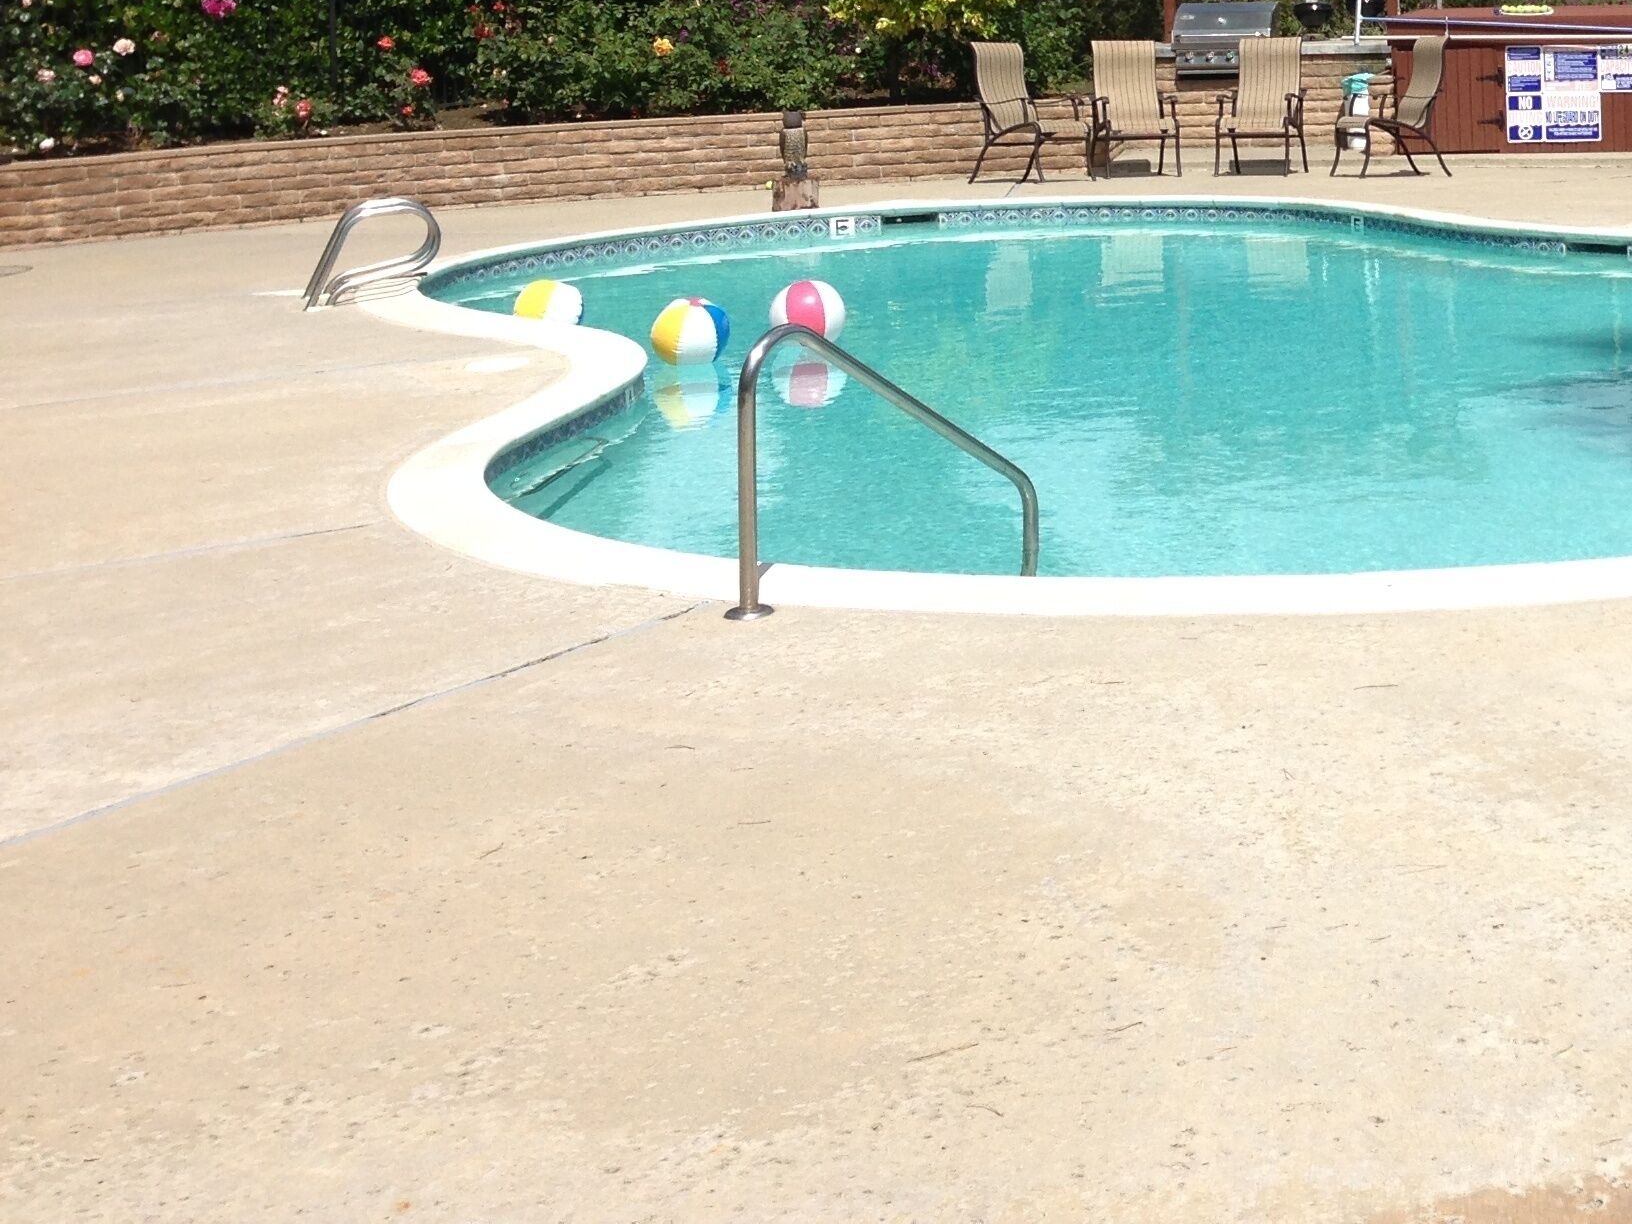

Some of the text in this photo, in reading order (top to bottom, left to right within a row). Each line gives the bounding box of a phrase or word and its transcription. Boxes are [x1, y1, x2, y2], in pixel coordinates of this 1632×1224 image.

[1518, 96, 1533, 109] NO
[1546, 111, 1599, 123] NO LIFEGUARD ON DUTY
